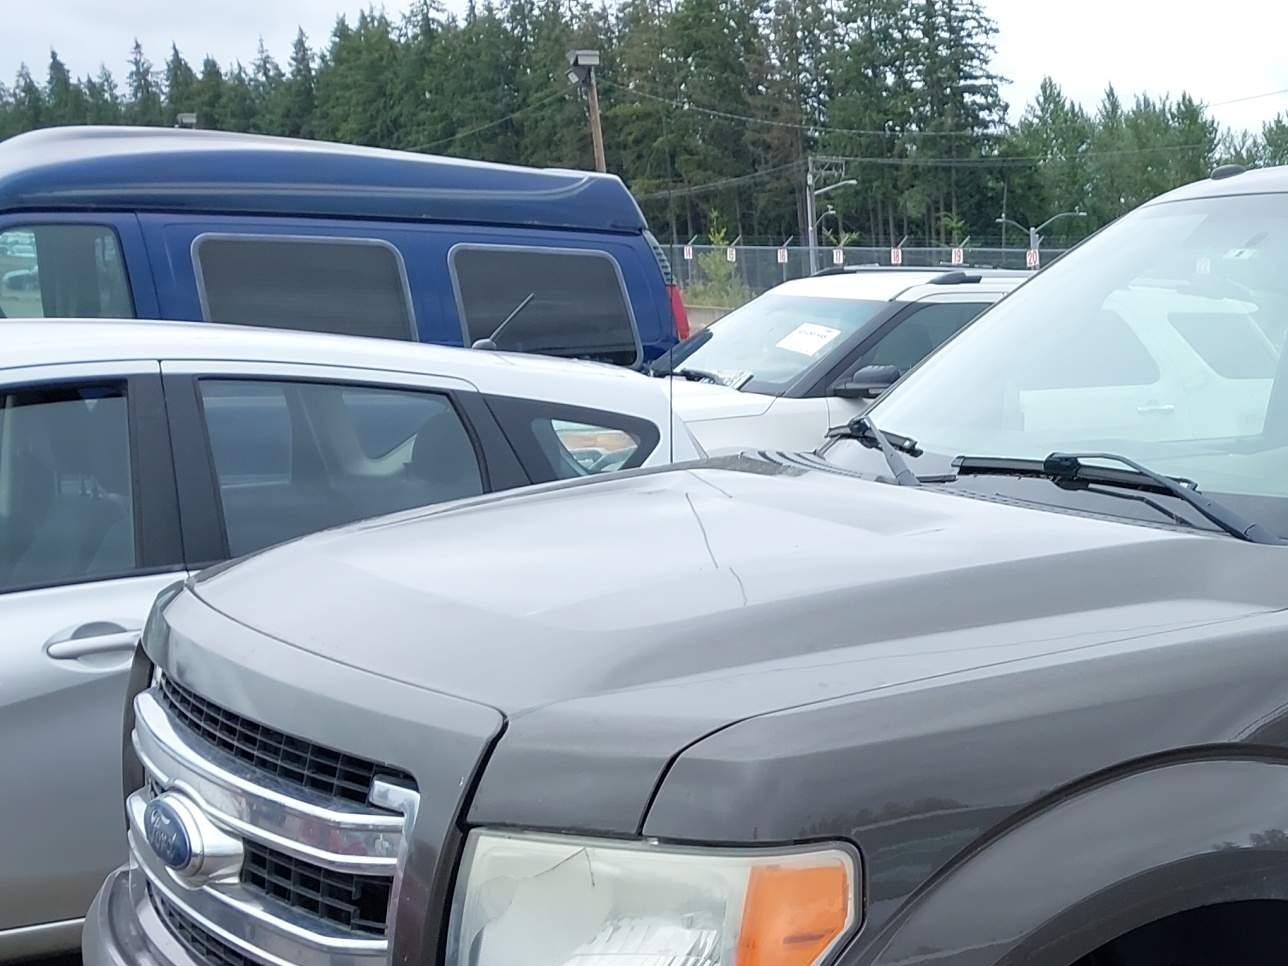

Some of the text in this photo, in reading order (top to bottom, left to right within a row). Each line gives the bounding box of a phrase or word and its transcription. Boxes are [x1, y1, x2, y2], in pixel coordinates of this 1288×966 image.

[953, 249, 962, 263] 19
[1027, 251, 1037, 265] 20
[150, 807, 178, 861] Ford
